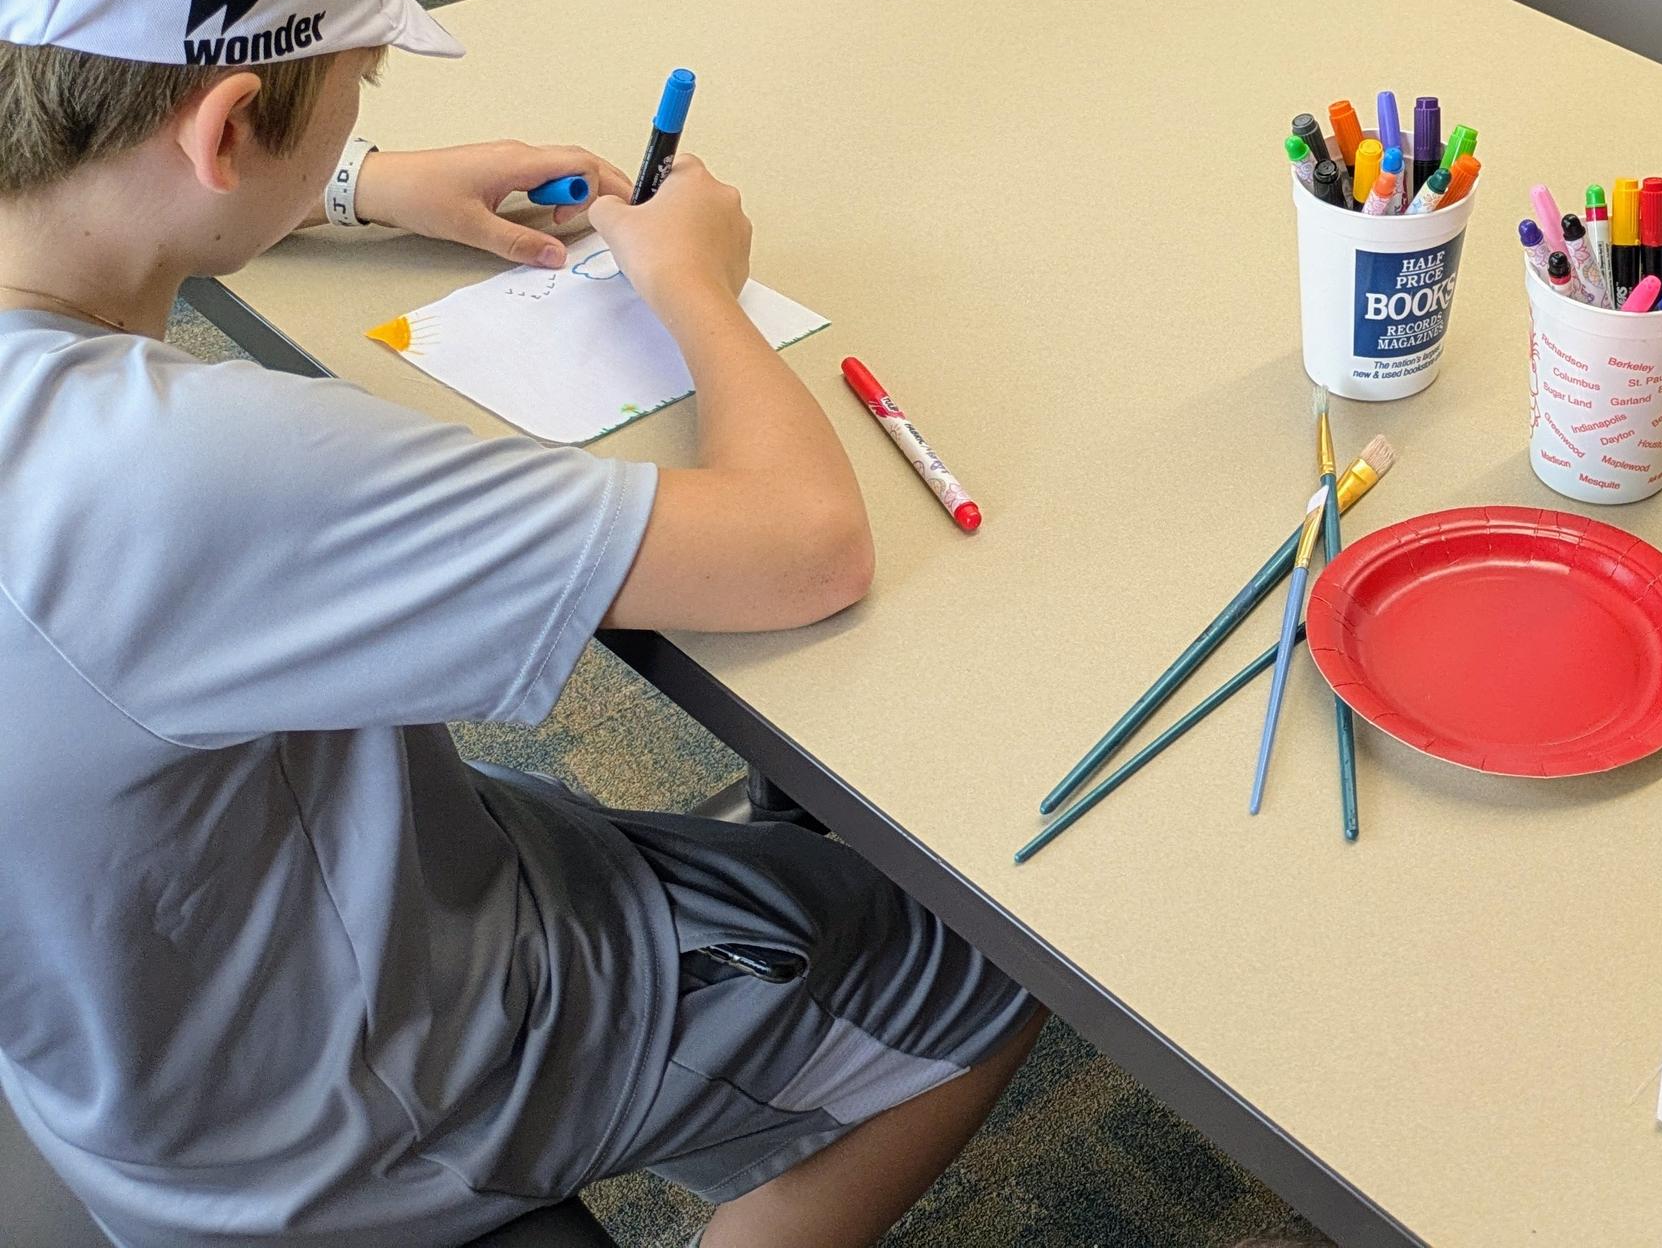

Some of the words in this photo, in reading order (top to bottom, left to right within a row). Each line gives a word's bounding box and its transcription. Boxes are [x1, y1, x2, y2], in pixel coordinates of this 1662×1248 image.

[1402, 251, 1445, 273] HALF
[1395, 267, 1444, 289] PRICE
[1364, 272, 1456, 321] BOOKS
[1377, 319, 1444, 350] MAGAZINES
[1386, 311, 1443, 337] RECORDS
[1374, 359, 1390, 370] The
[1391, 355, 1421, 370] nation's
[1541, 333, 1589, 372] Richardson
[1352, 370, 1372, 379] new
[1373, 370, 1380, 380] &
[1381, 369, 1402, 380] used
[1607, 356, 1656, 374] Berkeley
[1552, 366, 1601, 392] Columbus
[1627, 378, 1643, 388] St.
[1543, 381, 1567, 401] Sugar
[1567, 394, 1593, 409] Land
[1610, 394, 1653, 407] Garland
[1570, 413, 1628, 434] Indianapolis
[1544, 412, 1586, 459] Greenwood
[1599, 429, 1636, 446] Dayton
[1601, 455, 1652, 473] Maplewood
[1578, 472, 1621, 490] Mesquite
